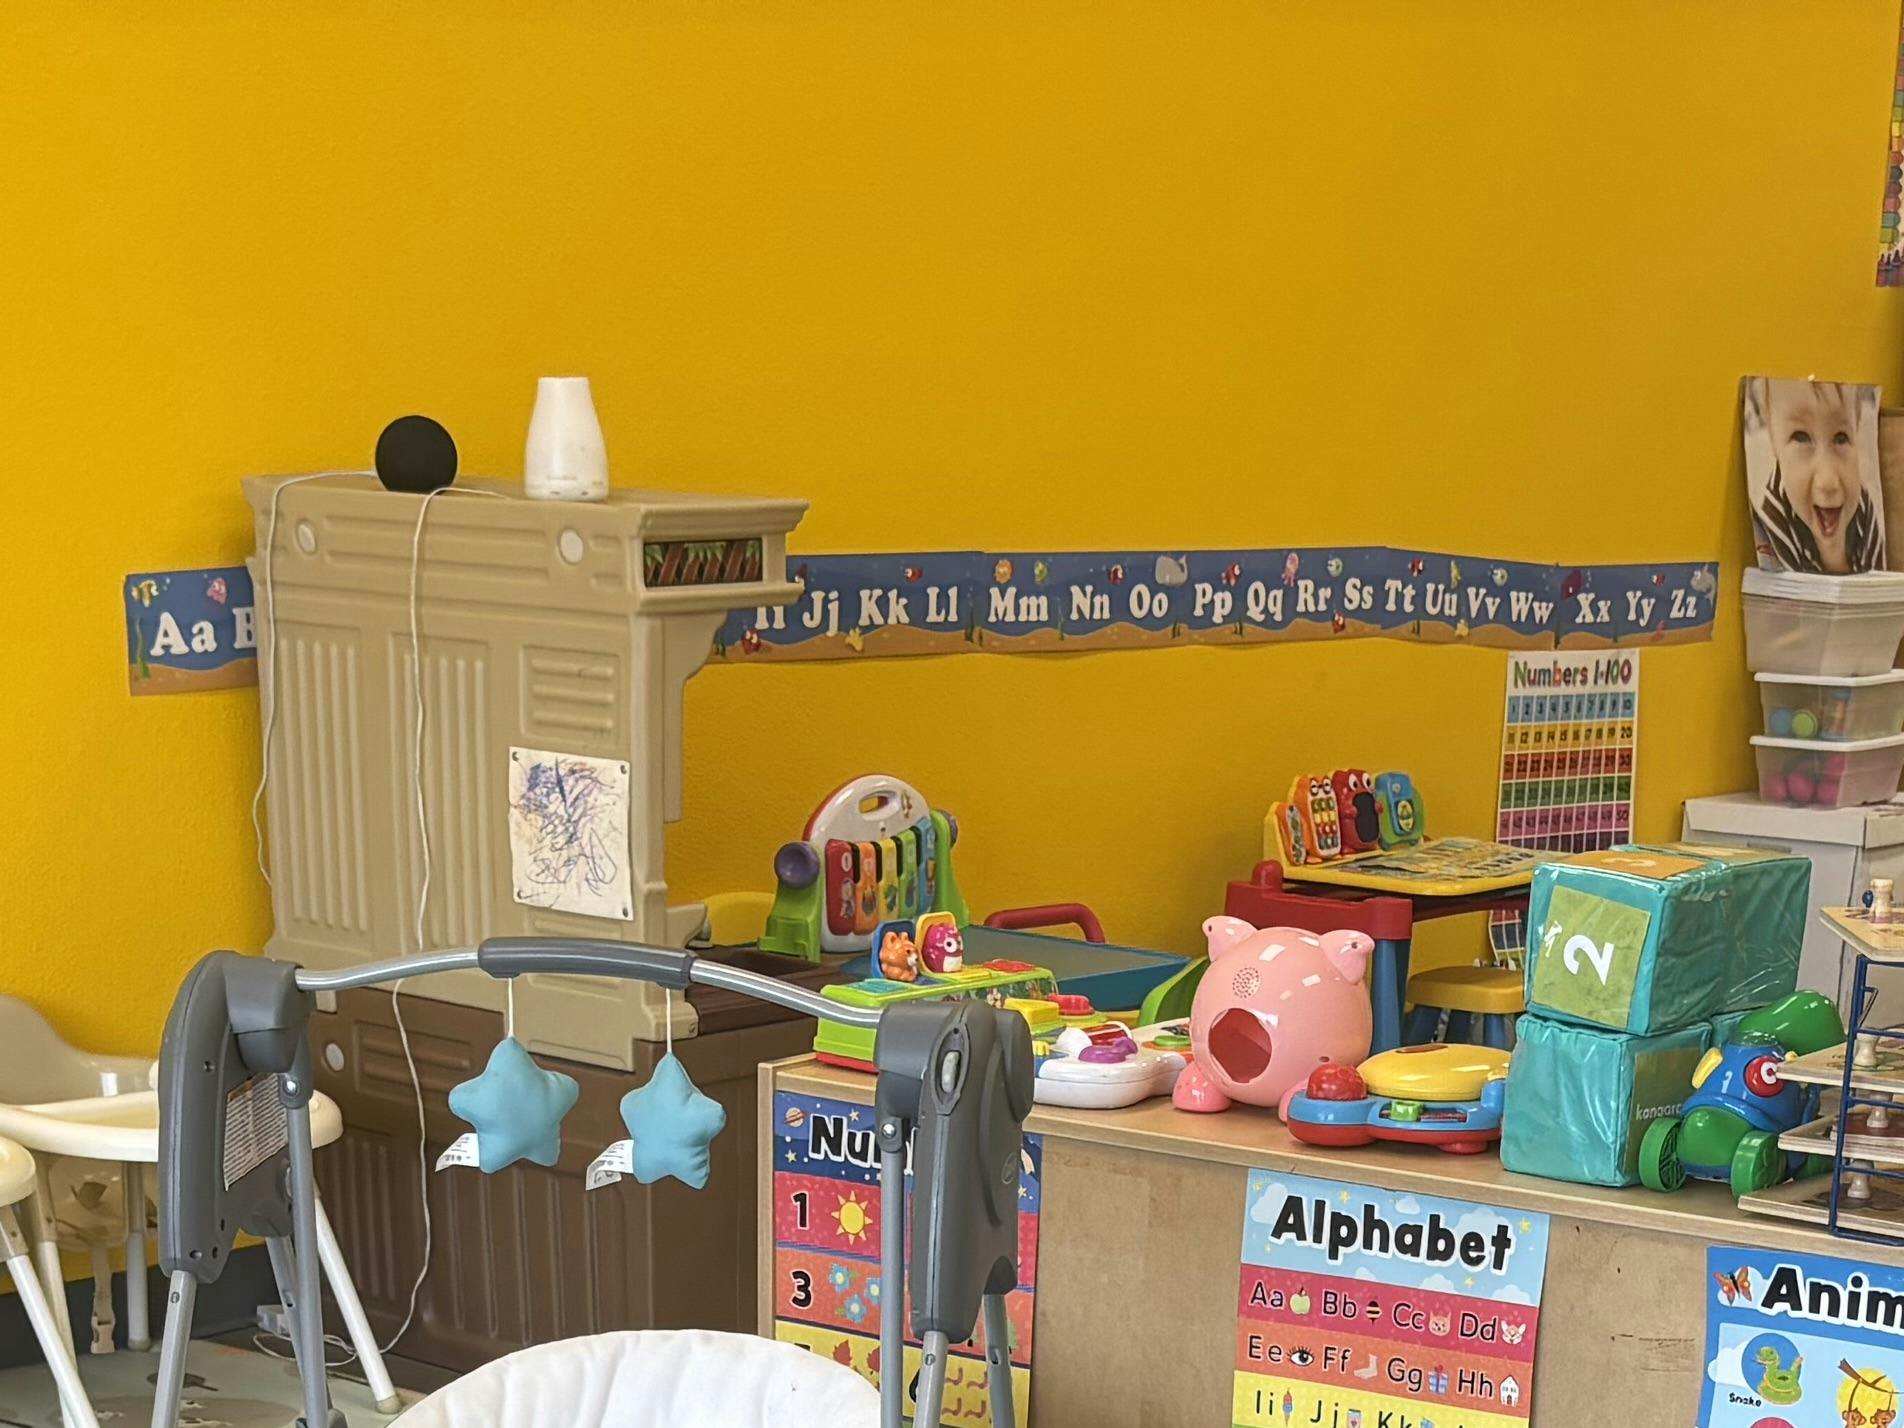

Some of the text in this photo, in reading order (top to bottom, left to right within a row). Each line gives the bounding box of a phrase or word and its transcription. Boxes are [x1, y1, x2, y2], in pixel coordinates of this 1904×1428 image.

[802, 578, 1696, 637] Jj Kk Ll Mm Nn Oo Pp Qq Rr Ss Tt Uu Vv Ww Xx Yy Zz
[150, 612, 217, 656] Aa
[1514, 659, 1632, 688] Numbers 1-100
[1563, 934, 1614, 986] 2
[793, 1193, 808, 1227] 1
[1271, 1196, 1511, 1271] Alphabet
[792, 1271, 812, 1308] 3
[1250, 1282, 1497, 1343] Aa Bb Cc Dd
[1247, 1335, 1494, 1399] Ee Ff Gg Hh
[1254, 1390, 1275, 1417] Ii
[1729, 1392, 1762, 1407] Snake
